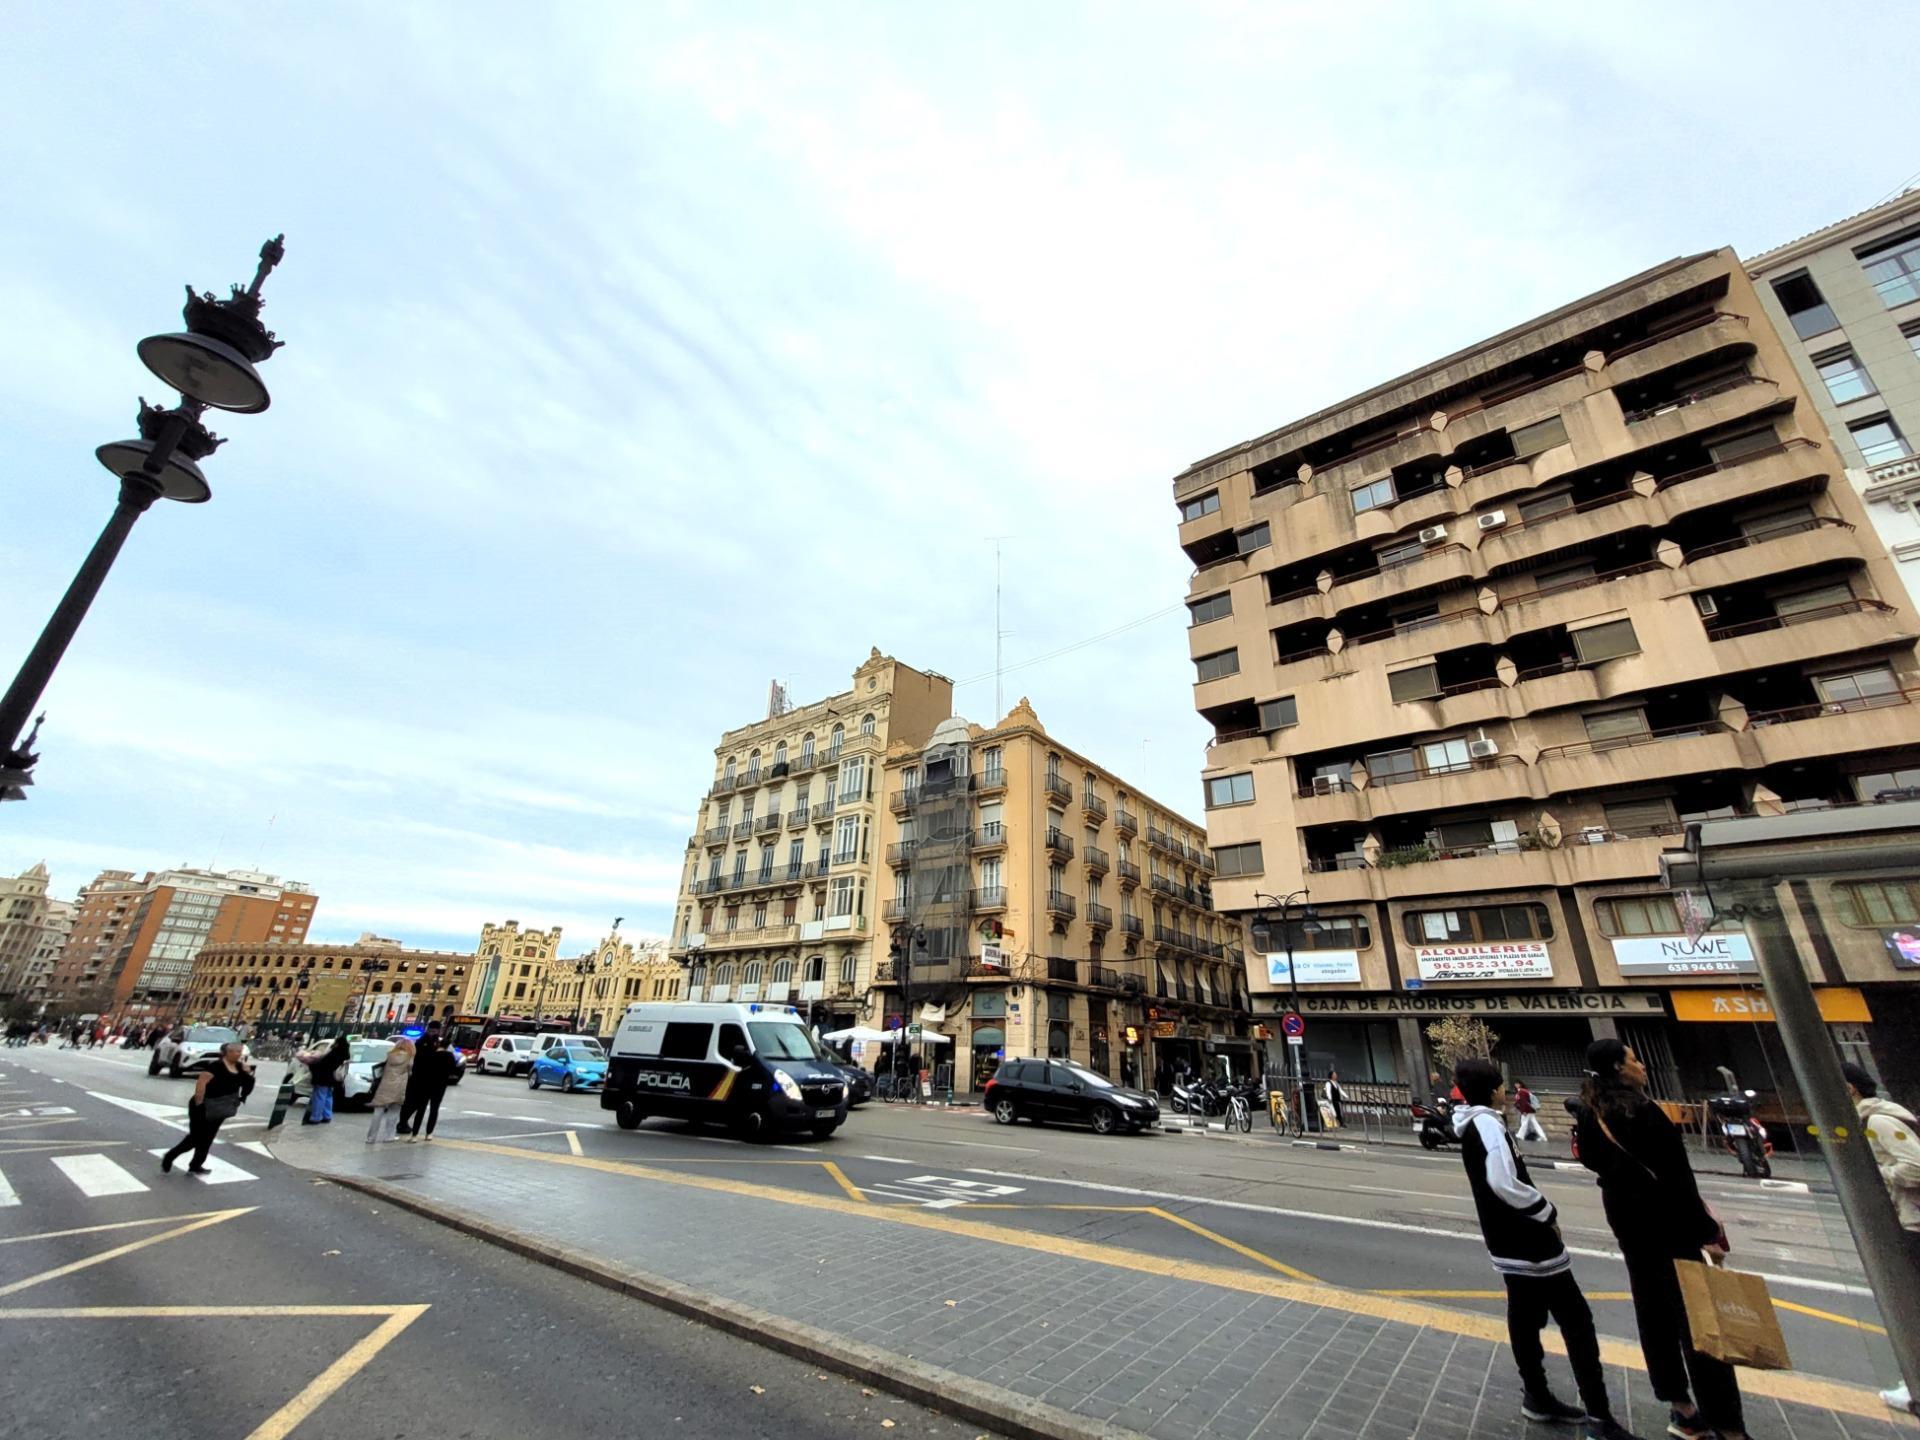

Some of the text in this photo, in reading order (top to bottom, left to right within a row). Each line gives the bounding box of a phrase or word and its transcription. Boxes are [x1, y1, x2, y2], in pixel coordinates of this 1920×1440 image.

[1421, 944, 1542, 956] ALQUILERES
[1661, 939, 1731, 956] NUWE
[1433, 960, 1534, 970] 96.352.31.94
[1668, 963, 1689, 972] 638
[1691, 963, 1714, 971] 946
[1307, 995, 1626, 1011] CAJA DE AHORROS DE VALENCIA
[1711, 996, 1768, 1013] ASH
